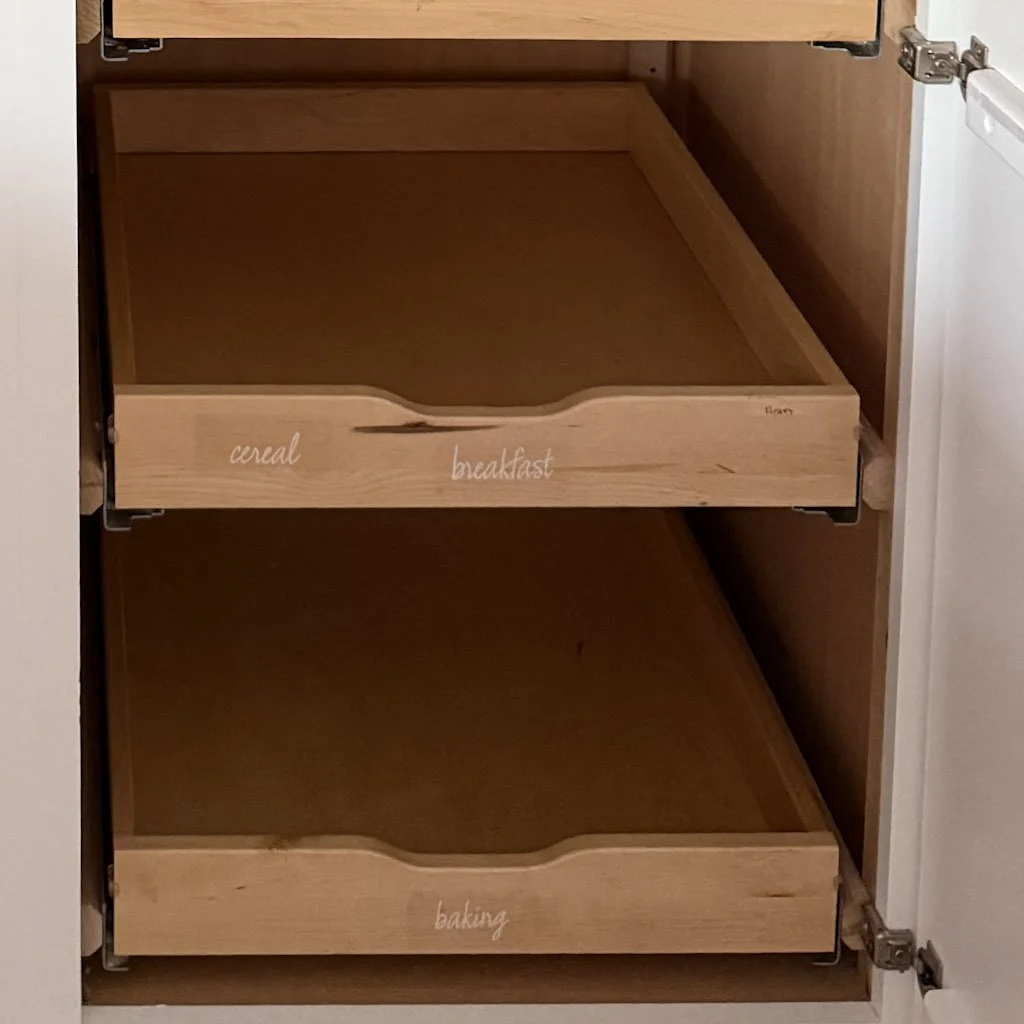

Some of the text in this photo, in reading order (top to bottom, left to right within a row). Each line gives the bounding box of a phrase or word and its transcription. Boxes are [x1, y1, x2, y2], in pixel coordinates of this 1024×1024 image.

[229, 431, 301, 466] cereal
[451, 444, 555, 481] breakfast
[433, 900, 509, 940] baking
